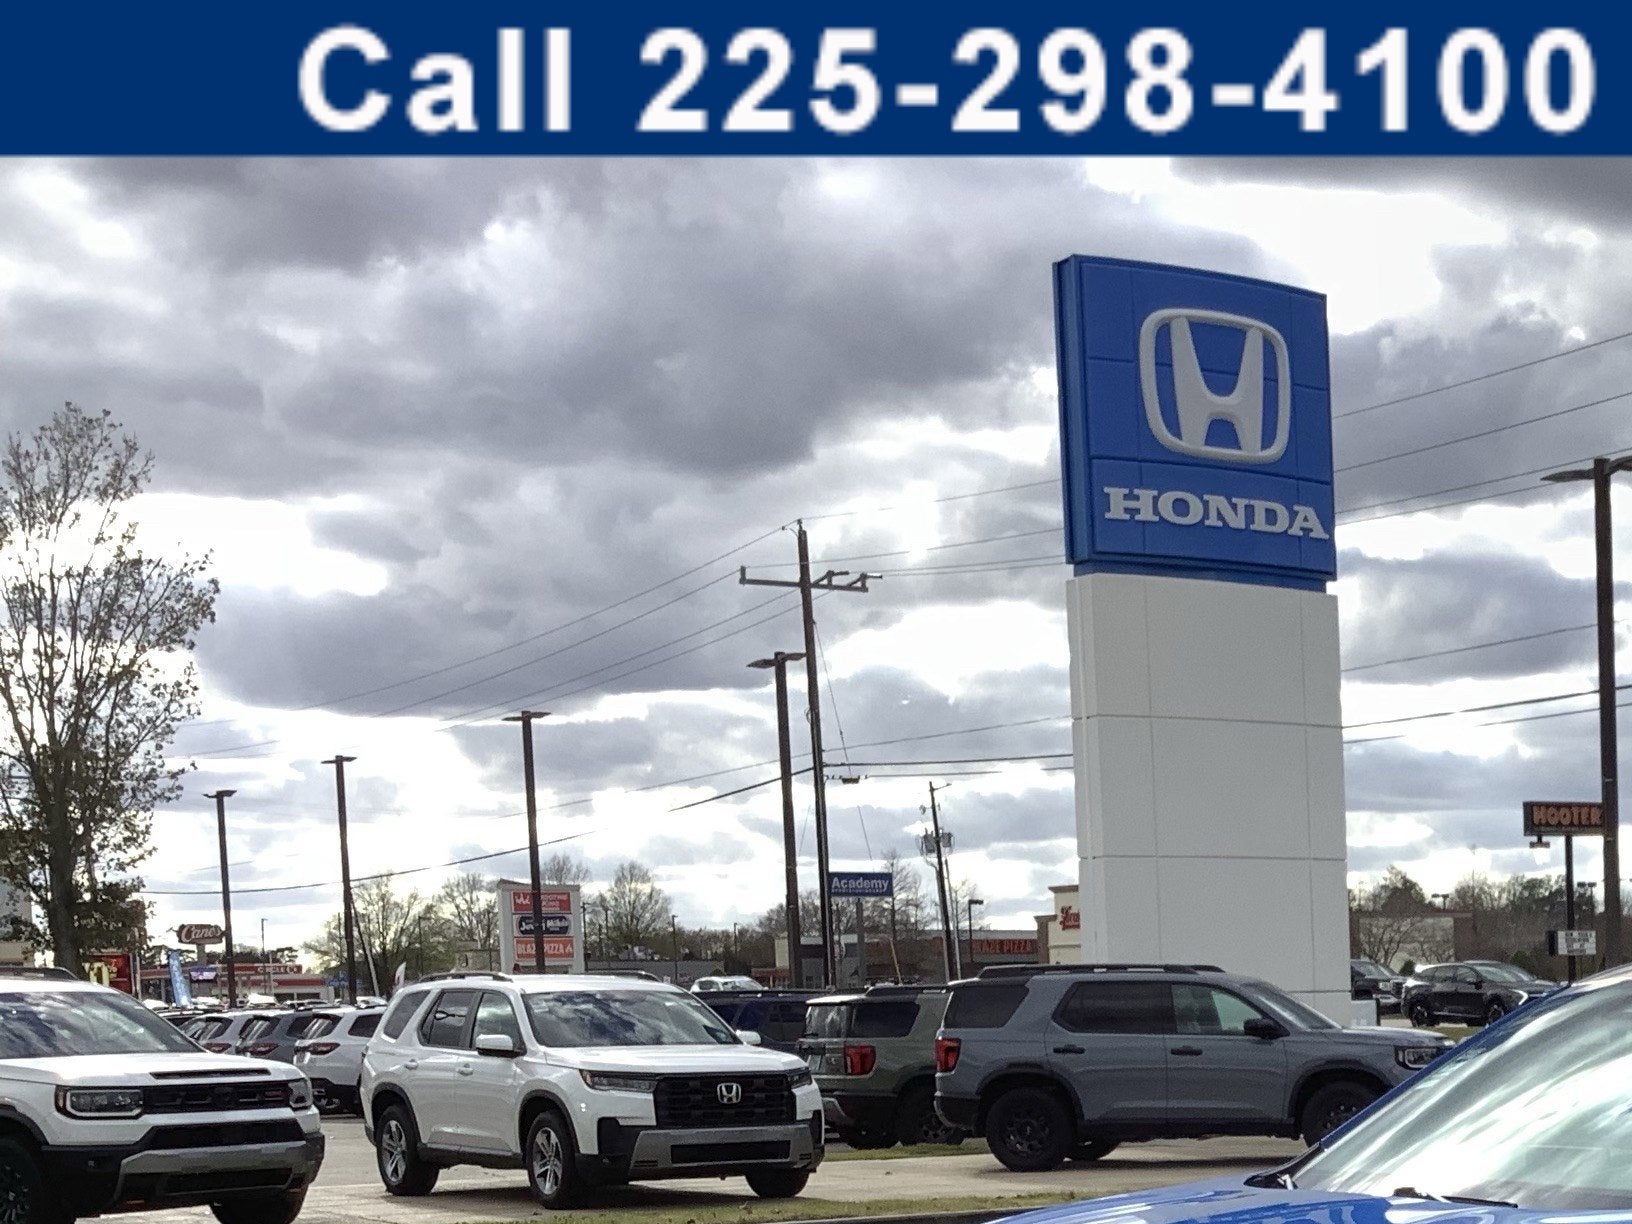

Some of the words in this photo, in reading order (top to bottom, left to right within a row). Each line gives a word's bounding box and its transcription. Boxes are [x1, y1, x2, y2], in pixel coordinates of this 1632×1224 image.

[1103, 486, 1330, 540] HONDA
[1533, 805, 1603, 825] HOOTER
[831, 876, 889, 892] Academy
